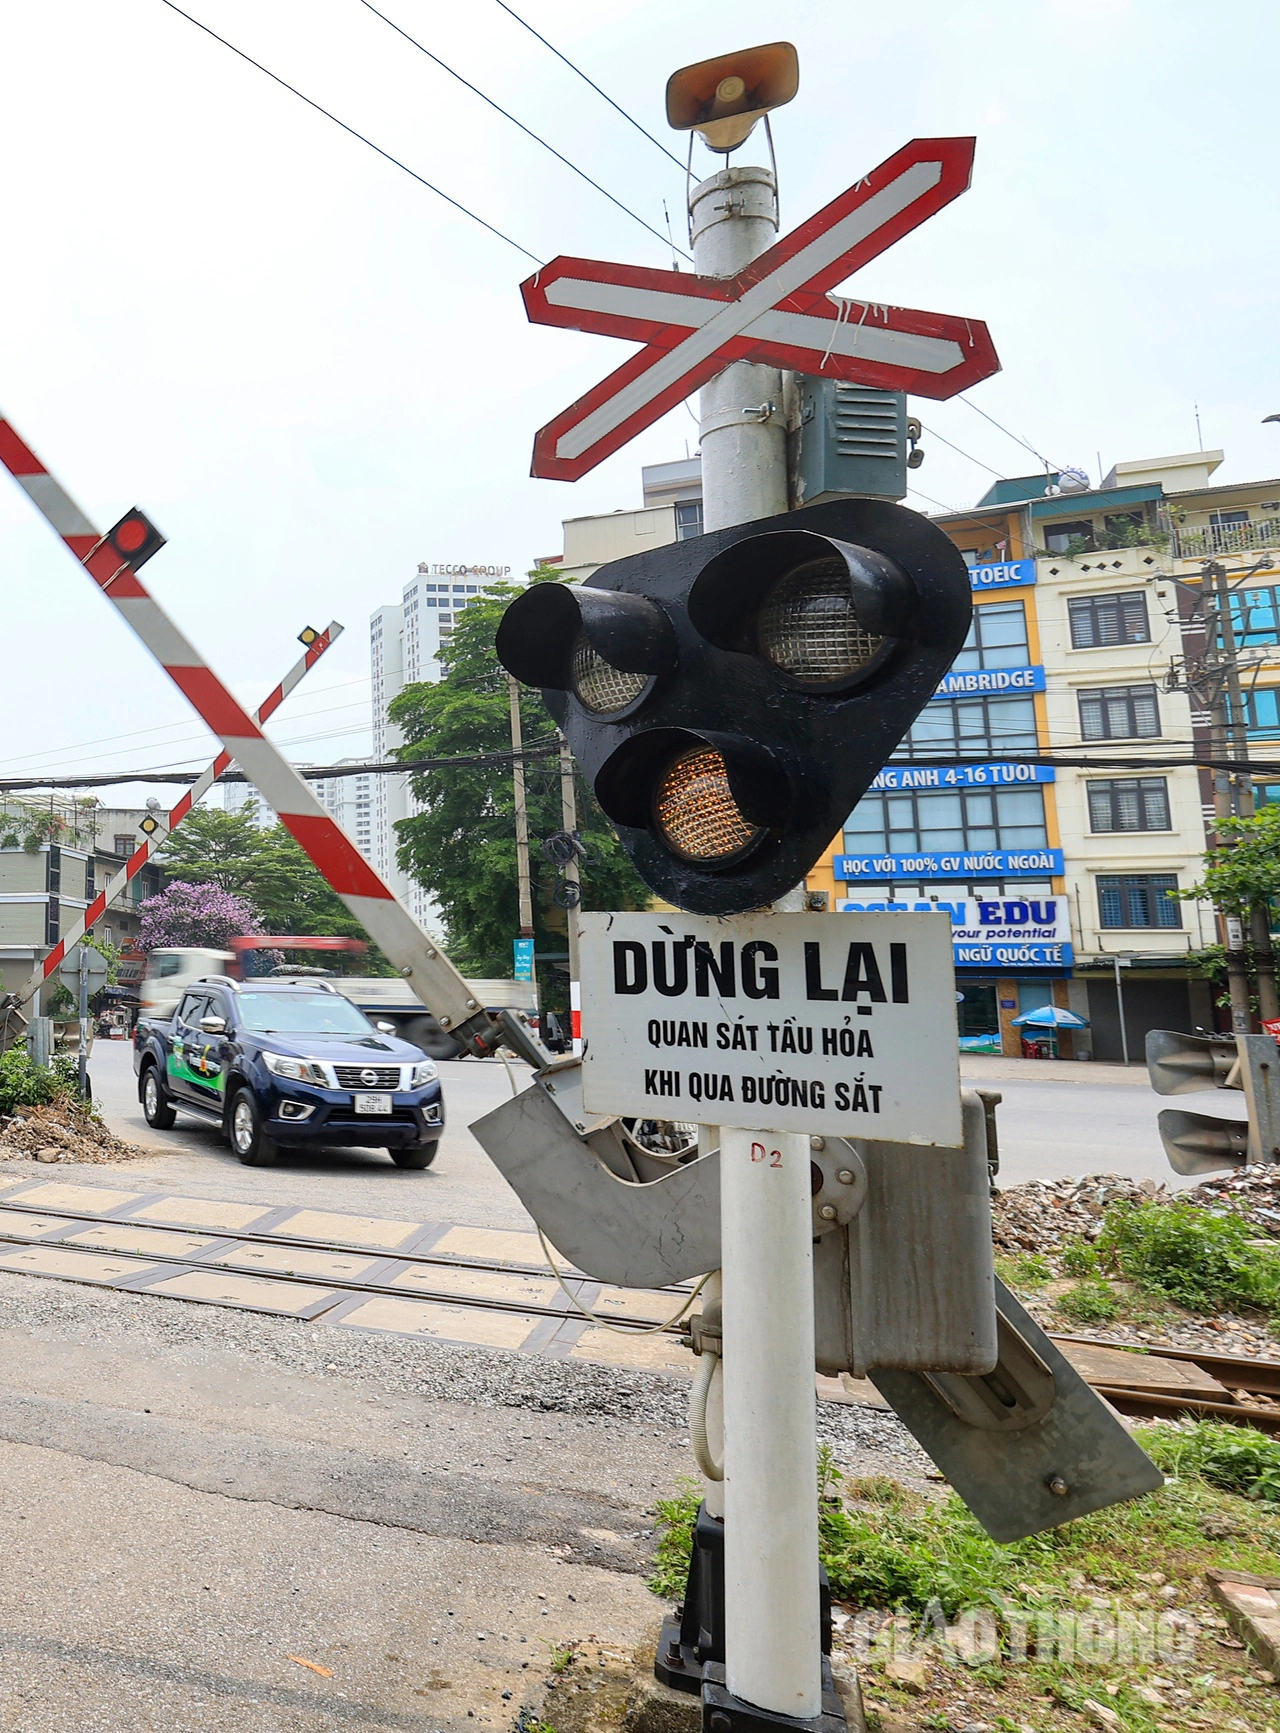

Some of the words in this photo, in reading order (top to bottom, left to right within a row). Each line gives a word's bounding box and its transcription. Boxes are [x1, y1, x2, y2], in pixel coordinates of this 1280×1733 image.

[432, 564, 468, 576] TECCO
[472, 565, 511, 576] GROUP
[969, 564, 1022, 585] TOEIC
[868, 771, 898, 788] NG
[901, 770, 939, 787] ANH
[945, 767, 987, 785] 4-16
[842, 859, 870, 876] HỌC
[873, 854, 896, 873] VỚI
[900, 857, 938, 872] 100%
[940, 856, 960, 871] GV
[964, 852, 1003, 870] NƯỚC
[1008, 850, 1054, 870] NGOÀI
[978, 901, 1056, 925] EDU
[986, 928, 1056, 940] potential
[958, 945, 993, 962] NGỮ
[996, 944, 1039, 963] QUỐC
[1042, 944, 1063, 962] TẾ
[613, 926, 780, 1000] DỪNG
[804, 942, 910, 1016] LẠI
[648, 1020, 708, 1048] QUAN
[716, 1015, 759, 1051] SÁT
[767, 1016, 814, 1054] TẦU
[822, 1016, 874, 1058] HỎA
[645, 1069, 681, 1097] KHI
[689, 1072, 734, 1102] QUA
[742, 1070, 826, 1110] ĐƯỜNG
[834, 1072, 883, 1114] SẮT
